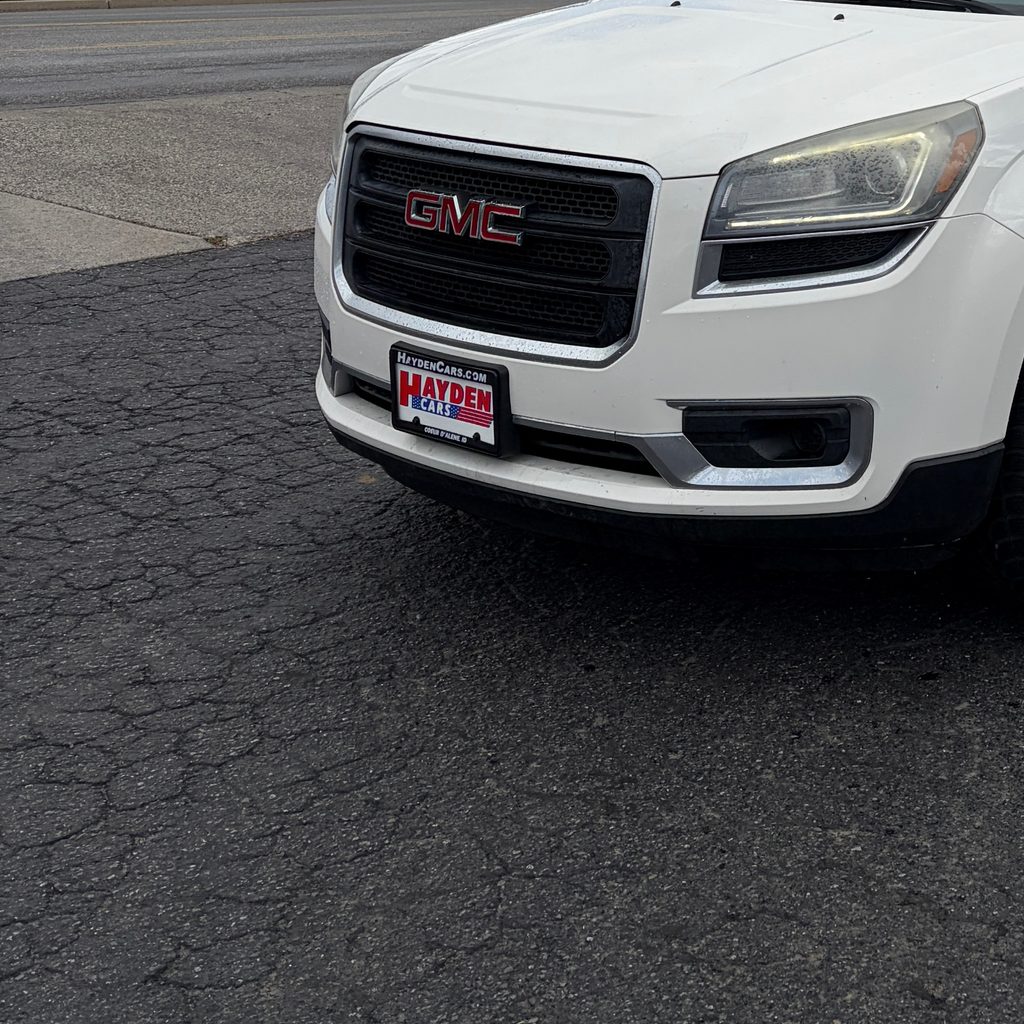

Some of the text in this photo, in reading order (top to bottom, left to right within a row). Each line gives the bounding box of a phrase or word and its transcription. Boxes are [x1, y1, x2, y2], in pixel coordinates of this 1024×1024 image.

[404, 188, 524, 247] GMC
[399, 369, 492, 413] HAYDEN
[420, 397, 452, 417] CARS
